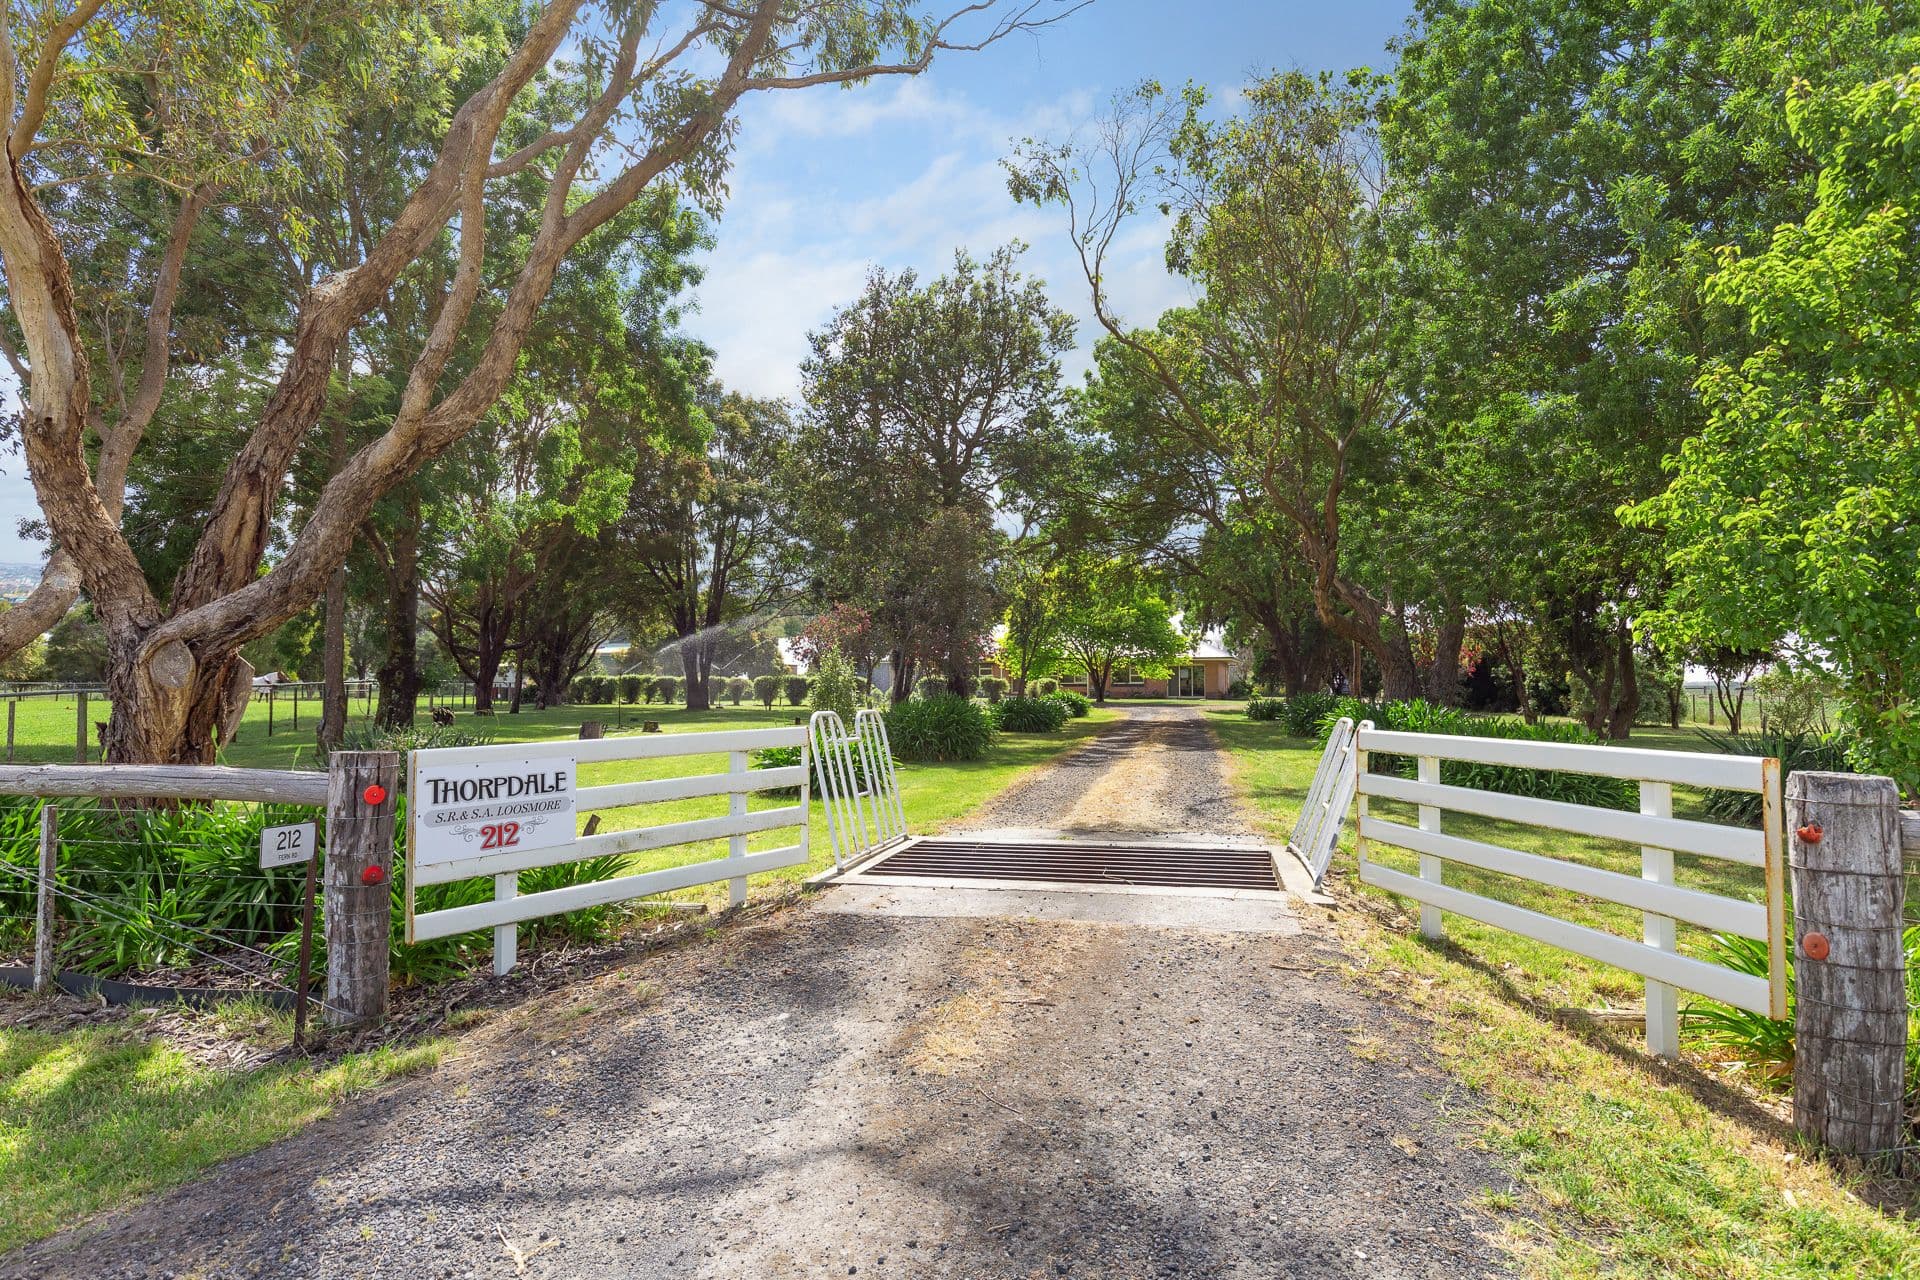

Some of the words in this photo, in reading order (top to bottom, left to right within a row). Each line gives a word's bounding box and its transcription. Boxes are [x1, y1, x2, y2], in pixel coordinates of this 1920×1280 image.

[426, 771, 567, 804] THORPDALE
[497, 799, 562, 817] LOOSMORE
[276, 829, 302, 851] 212
[480, 821, 521, 850] 212
